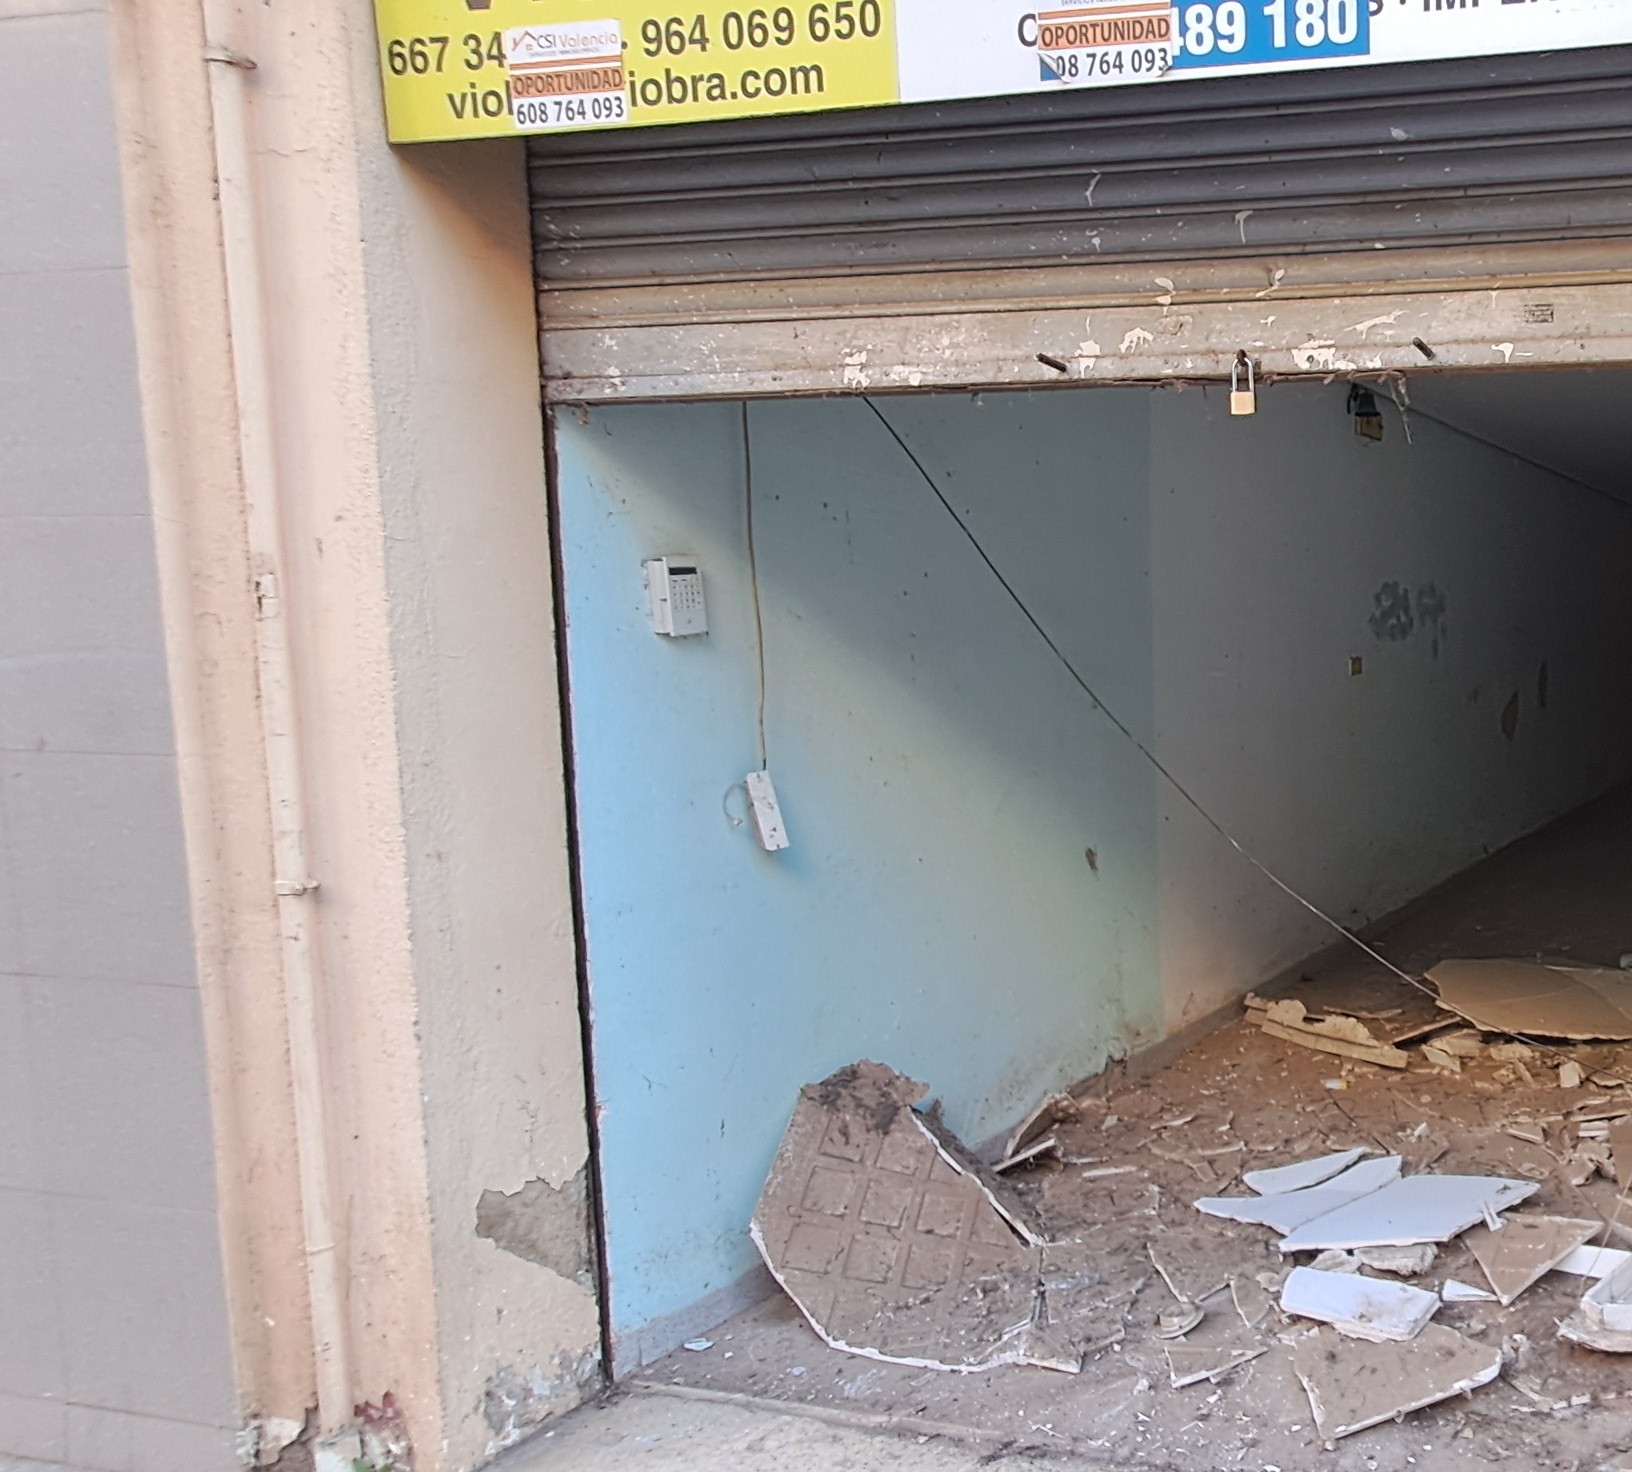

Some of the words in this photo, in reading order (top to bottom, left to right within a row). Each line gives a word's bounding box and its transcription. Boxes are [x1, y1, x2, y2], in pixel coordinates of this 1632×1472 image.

[641, 15, 709, 57] 964
[723, 7, 794, 50] 069
[808, 0, 881, 42] 650
[1041, 18, 1170, 47] OPORTUNIDAD
[1263, 0, 1358, 48] 180
[537, 34, 557, 49] CSI
[560, 33, 618, 48] Valencia
[388, 36, 449, 75] 667
[1086, 51, 1124, 76] 764
[1131, 48, 1168, 73] 093
[514, 69, 621, 95] OPORTUNIDAD
[516, 103, 548, 125] 608
[553, 99, 586, 121] 764
[592, 97, 624, 119] 093
